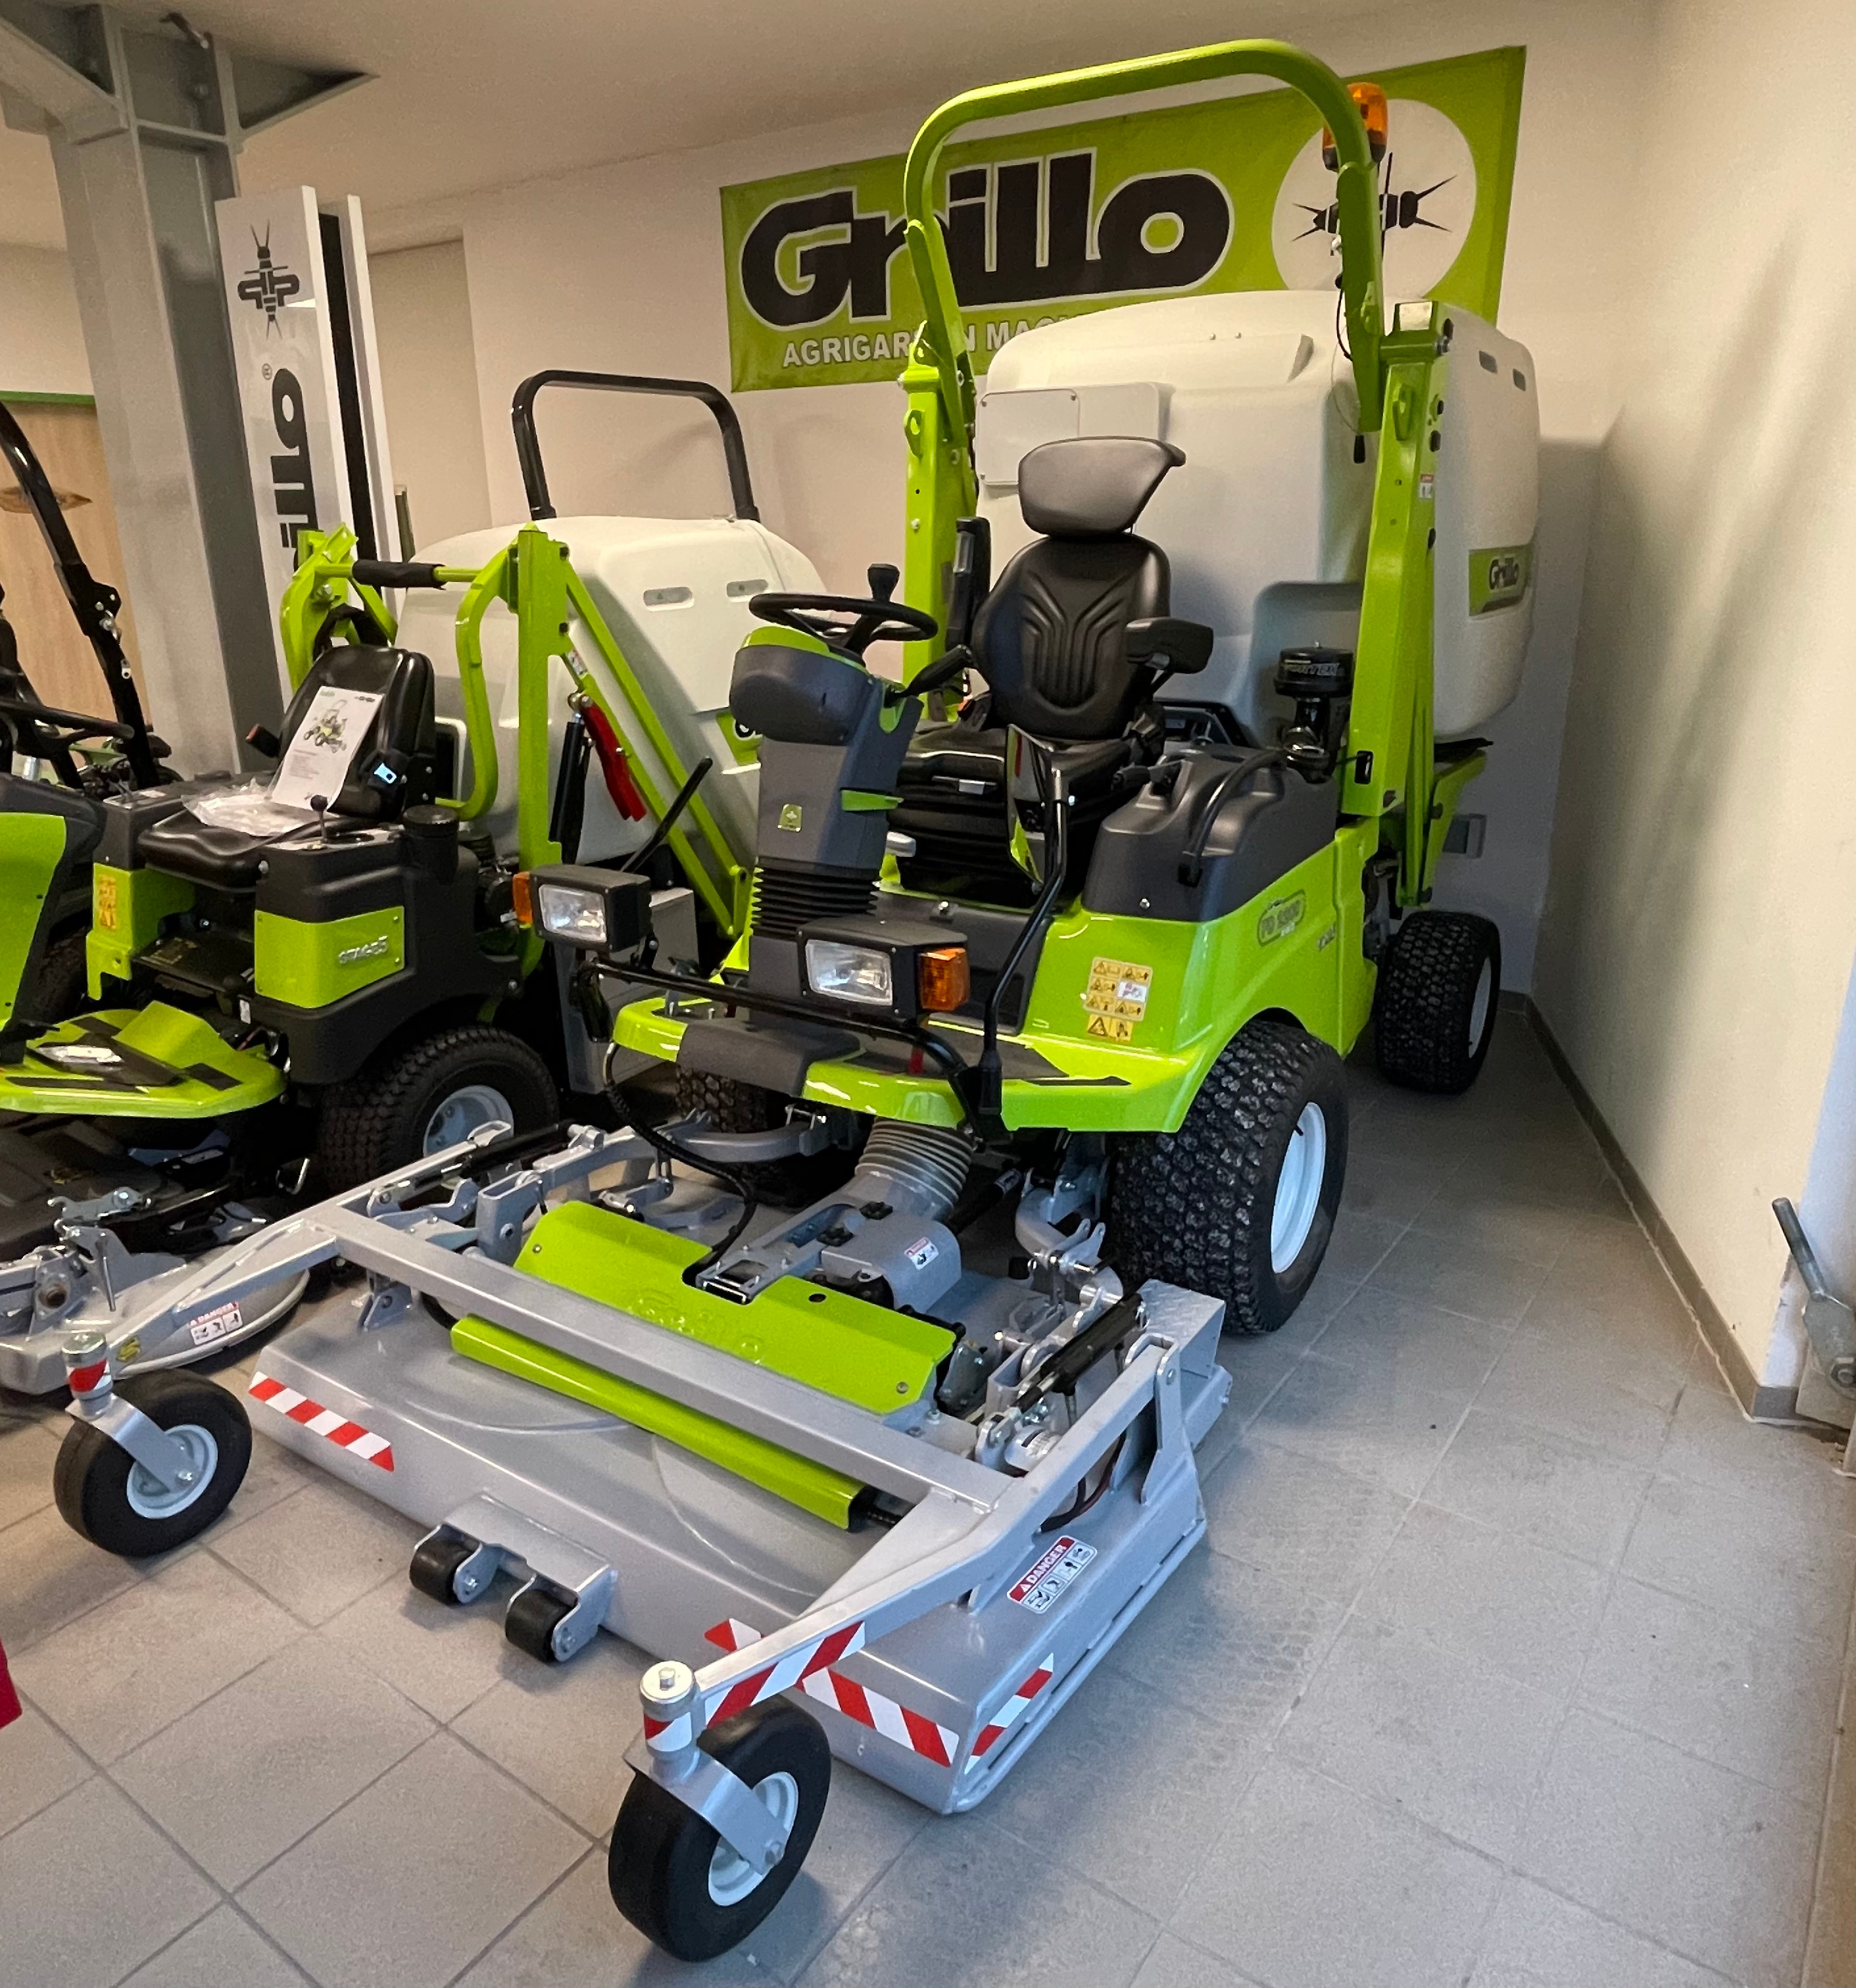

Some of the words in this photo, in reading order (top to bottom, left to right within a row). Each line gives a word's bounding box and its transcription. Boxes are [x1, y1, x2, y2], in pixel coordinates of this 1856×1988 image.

[740, 150, 1233, 328] Grillo
[783, 321, 976, 368] AGRIGARN
[270, 367, 320, 567] illo
[1489, 557, 1519, 590] Grillo
[1026, 1544, 1067, 1584] DANGER
